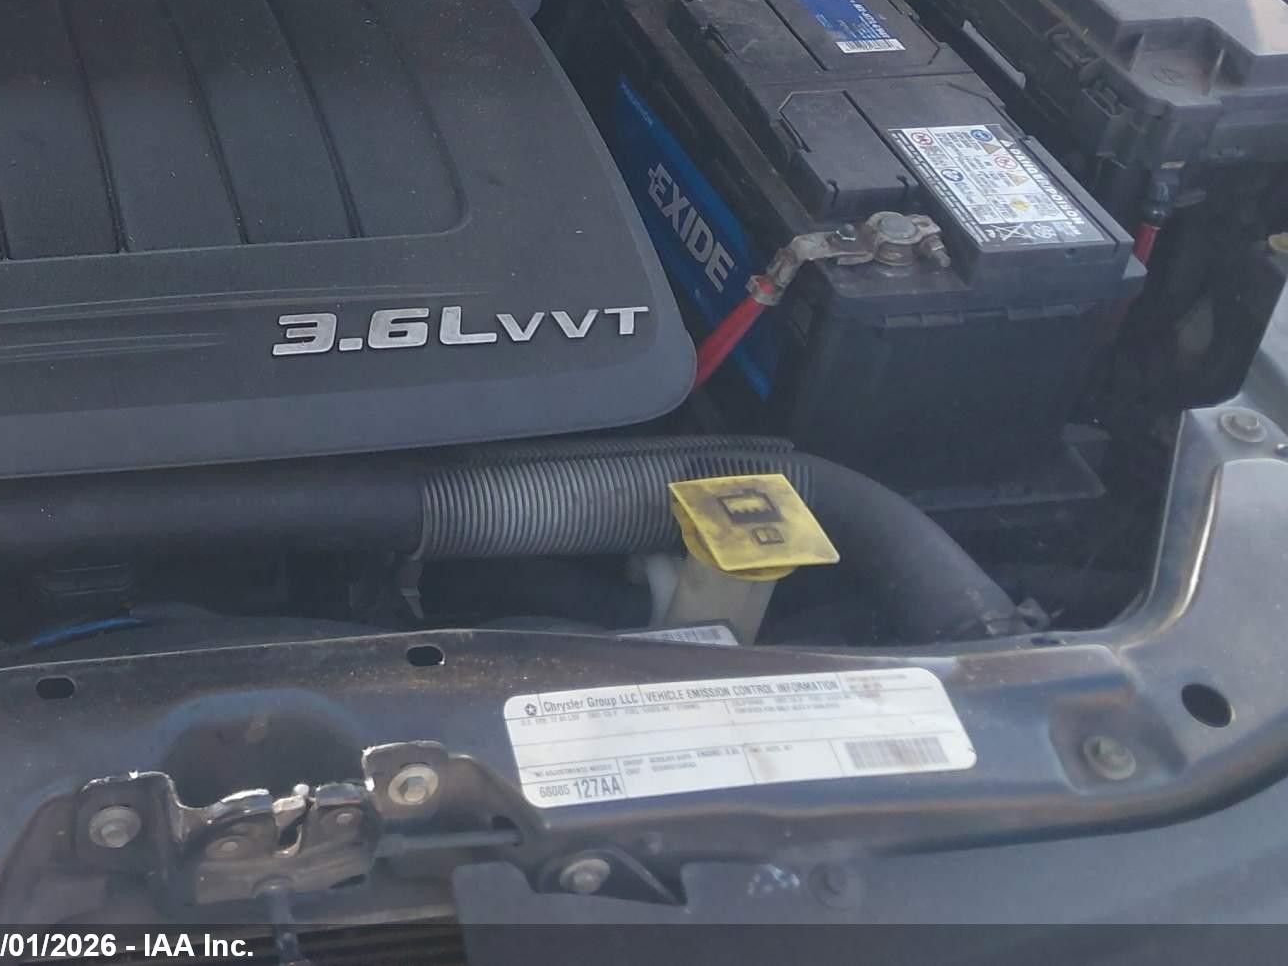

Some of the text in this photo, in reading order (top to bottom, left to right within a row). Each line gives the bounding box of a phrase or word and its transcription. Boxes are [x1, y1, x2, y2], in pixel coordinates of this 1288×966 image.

[648, 162, 736, 293] EXIDE
[644, 689, 684, 702] VEHICLE
[685, 686, 731, 699] EMISSION
[731, 683, 775, 696] CONTROL
[775, 678, 839, 694] INFORMATION
[542, 693, 639, 713] Chrysler Group LLC
[572, 776, 623, 798] 127AA
